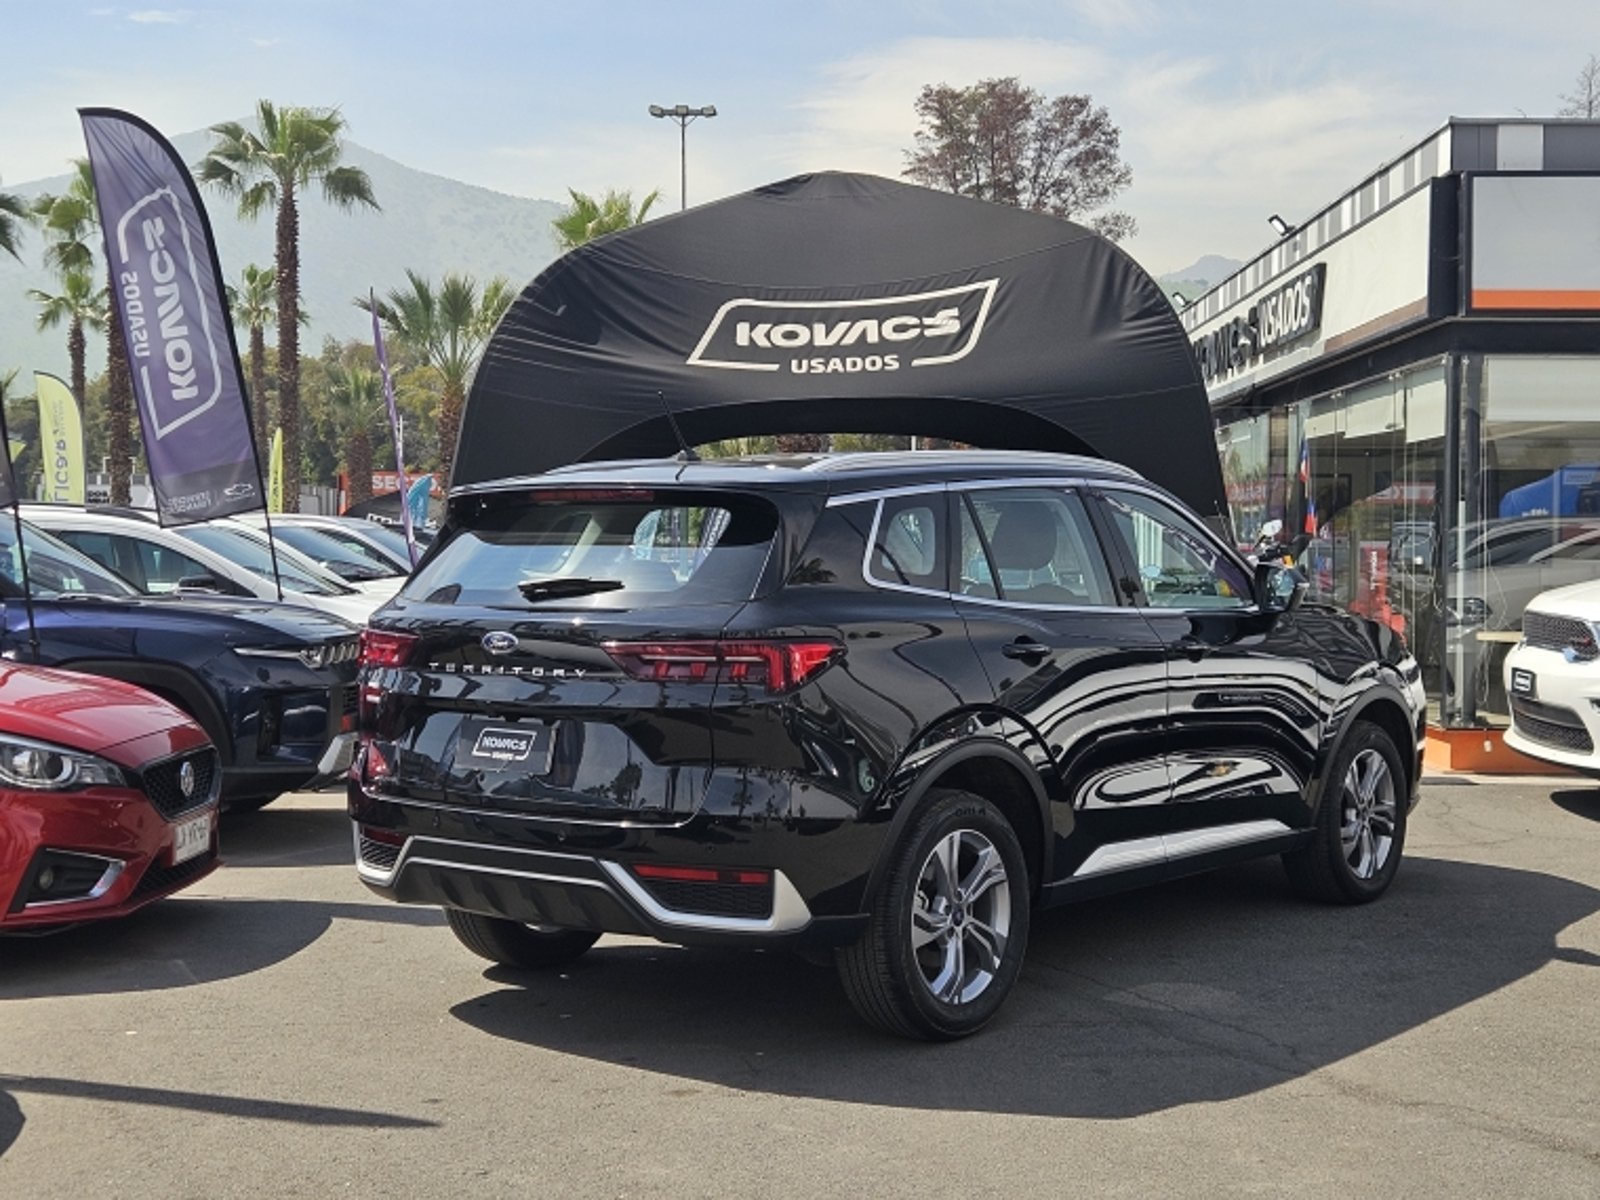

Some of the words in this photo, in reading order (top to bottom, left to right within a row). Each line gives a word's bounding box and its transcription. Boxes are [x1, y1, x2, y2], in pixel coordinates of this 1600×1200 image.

[1260, 275, 1312, 348] USADOS
[736, 307, 961, 348] KOVACS
[791, 355, 900, 374] USADOS
[428, 662, 587, 678] TERRITORY
[482, 736, 527, 750] KOVACS
